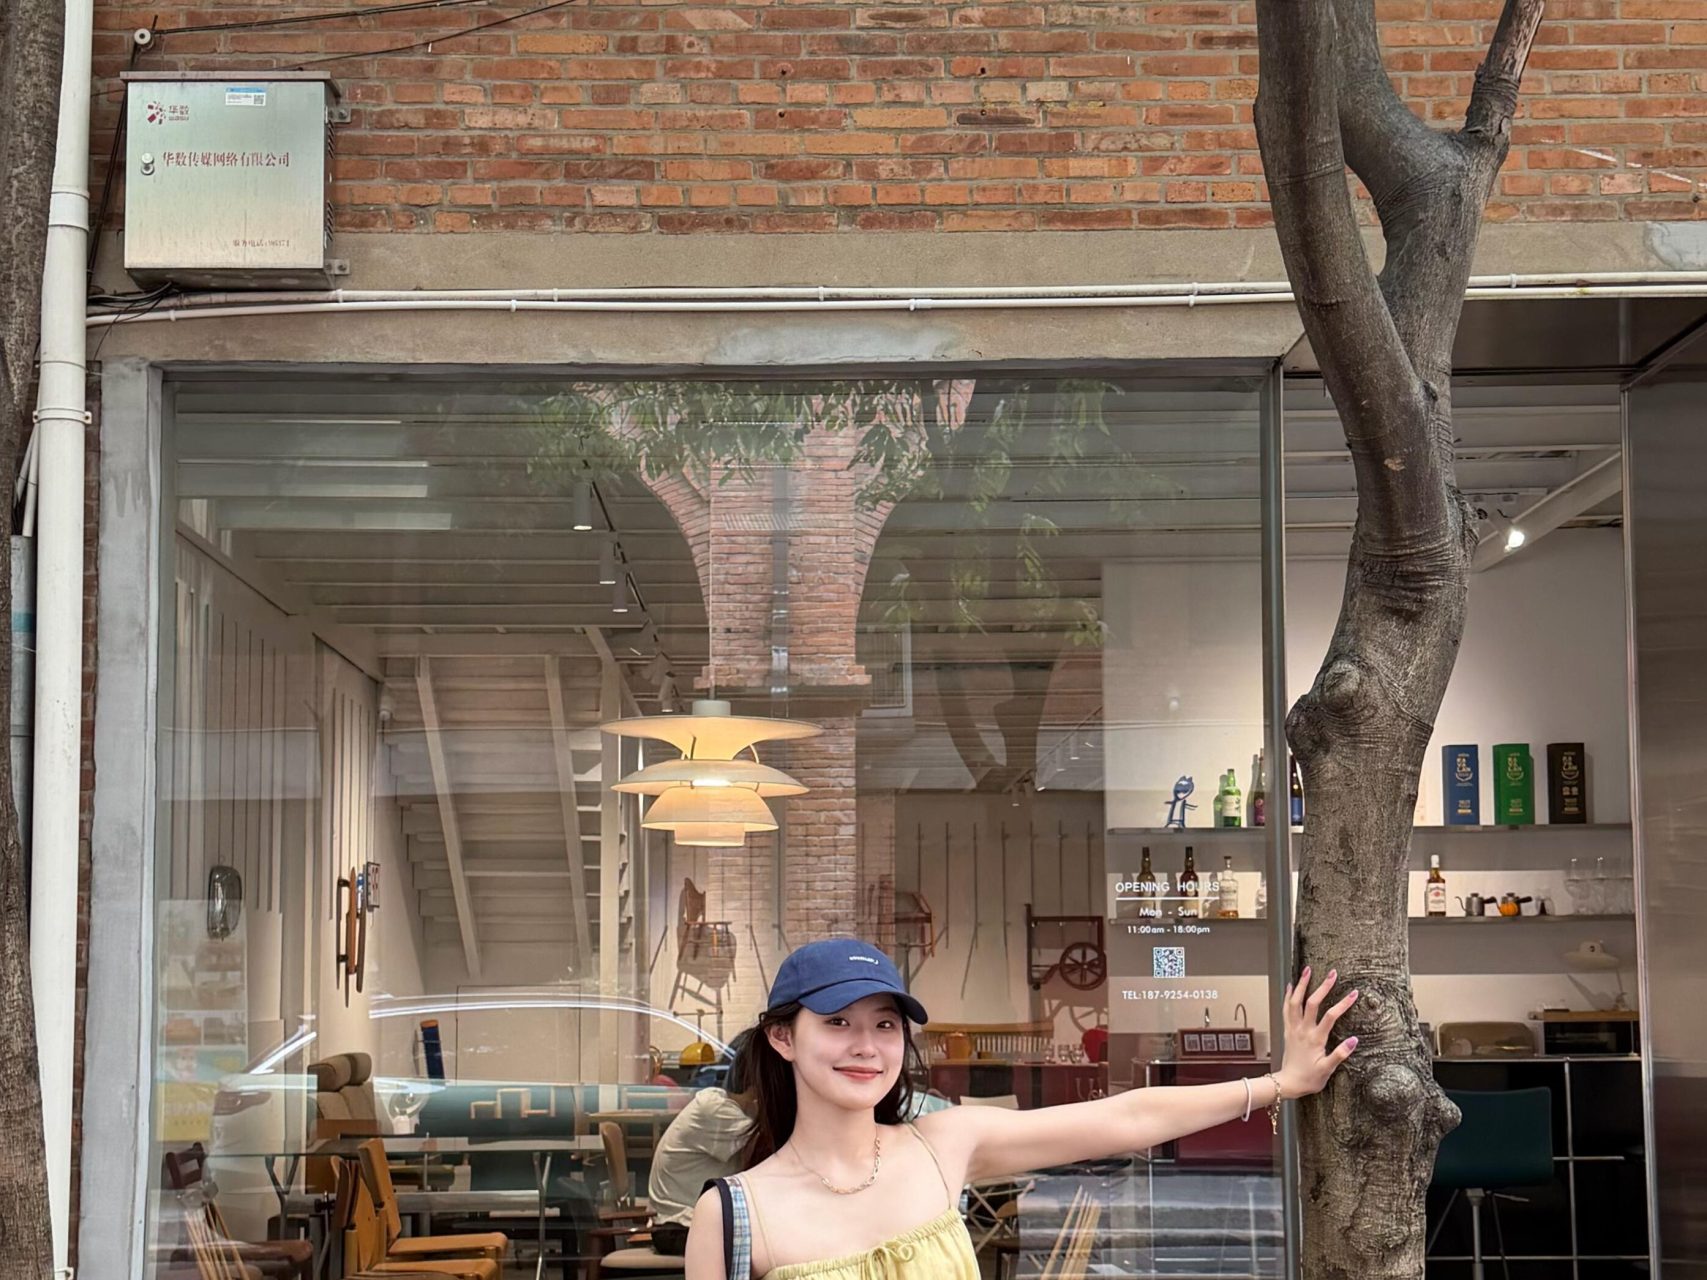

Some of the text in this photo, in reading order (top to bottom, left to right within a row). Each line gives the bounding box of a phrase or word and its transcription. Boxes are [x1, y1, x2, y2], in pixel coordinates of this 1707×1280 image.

[163, 152, 290, 167] 华数传媒网络有限公司
[1115, 882, 1220, 893] OPENING HOURS
[1139, 907, 1163, 917] Mon
[1178, 907, 1198, 917] Sun
[1127, 925, 1164, 934] 11:00am
[1173, 925, 1210, 935] 18:00pm
[1122, 990, 1219, 1000] TEL:187-9254-0138
